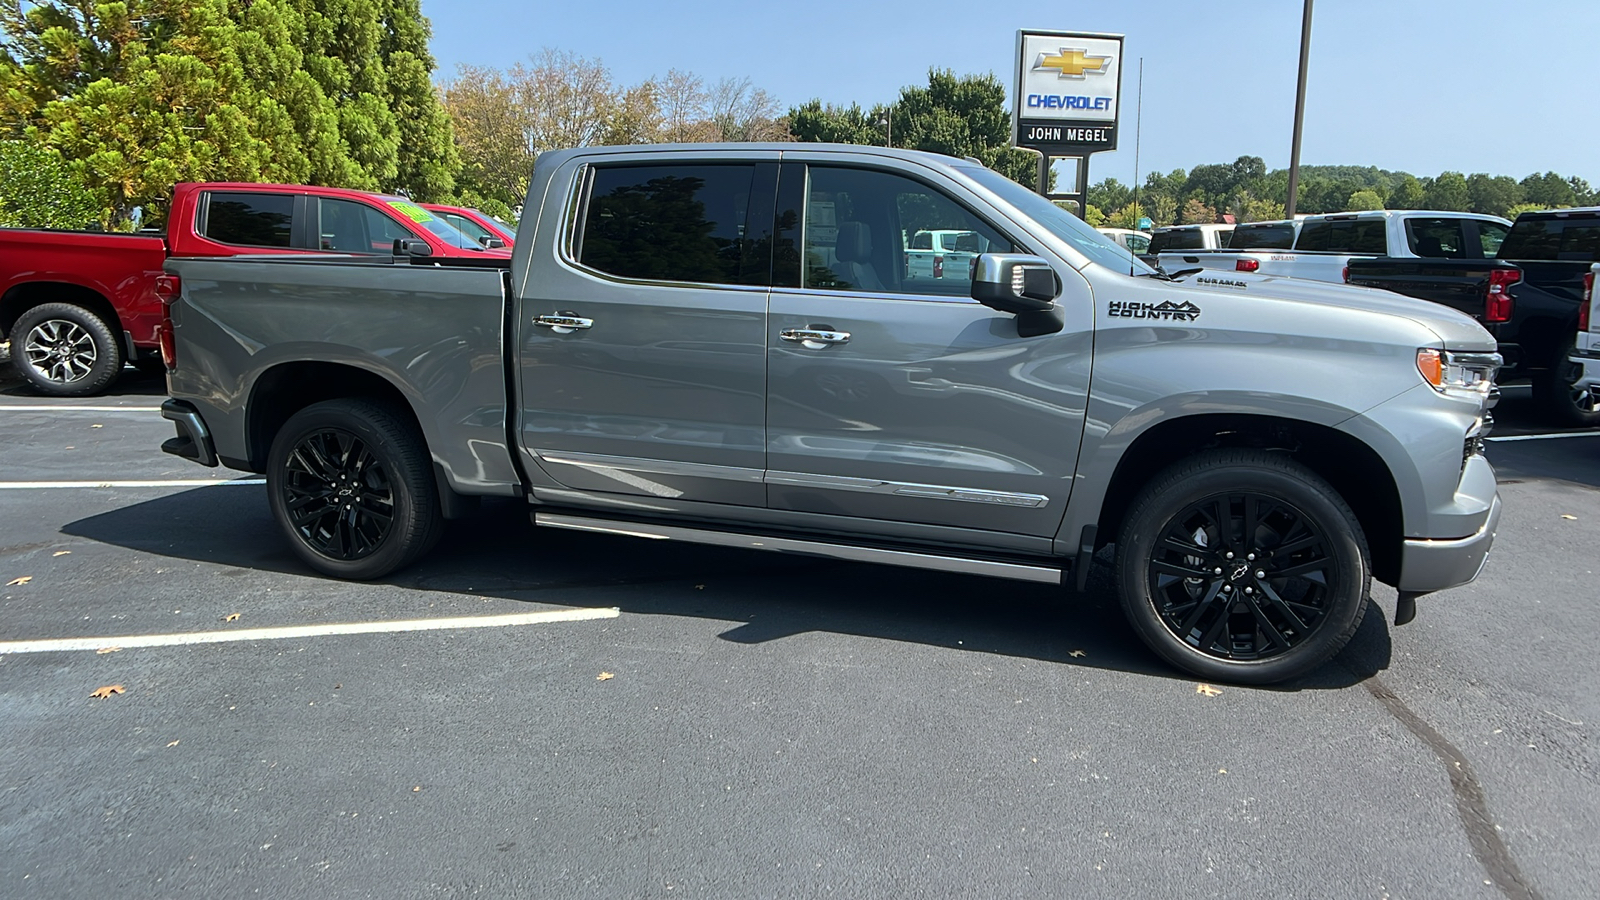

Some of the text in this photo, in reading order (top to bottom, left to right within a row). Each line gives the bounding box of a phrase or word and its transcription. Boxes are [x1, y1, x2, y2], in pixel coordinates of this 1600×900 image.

[1028, 94, 1112, 111] CHEVROLET
[1028, 127, 1108, 142] JOHN MEGEL
[1197, 277, 1247, 287] DURAMAX
[1109, 301, 1154, 310] HIGH
[1108, 309, 1200, 321] COUNTRY
